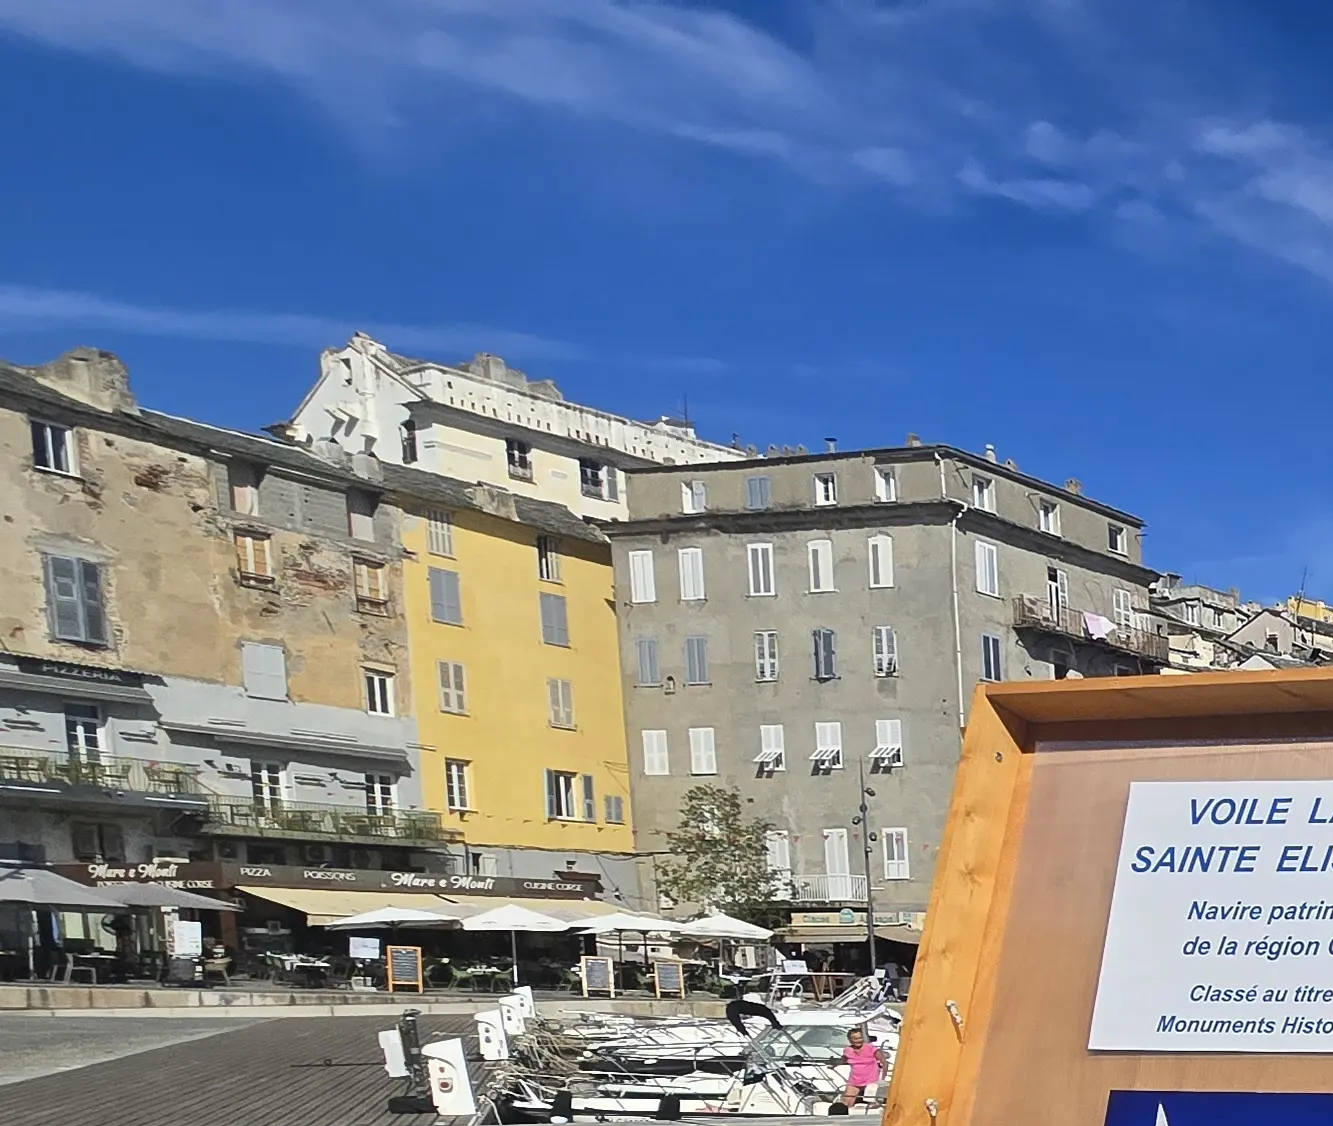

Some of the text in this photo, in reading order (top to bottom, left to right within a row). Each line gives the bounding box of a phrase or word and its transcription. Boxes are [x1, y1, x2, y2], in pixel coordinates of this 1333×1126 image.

[42, 664, 122, 682] PIZZERIA
[1190, 797, 1293, 825] VOILE
[1130, 845, 1261, 873] SAINTE
[88, 863, 179, 879] Mare e Monti
[240, 867, 272, 877] PIZZA
[303, 870, 356, 881] POISSONS
[391, 872, 496, 890] Mare e Monti
[523, 881, 584, 892] CUISINE CORSE
[1187, 900, 1262, 921] Navire
[1182, 935, 1211, 956] de
[1217, 935, 1238, 956] la
[1244, 935, 1320, 960] région
[1189, 984, 1257, 1003] Classé
[1262, 988, 1288, 1003] au
[1294, 985, 1333, 1003] titre
[1156, 1015, 1276, 1034] Monuments
